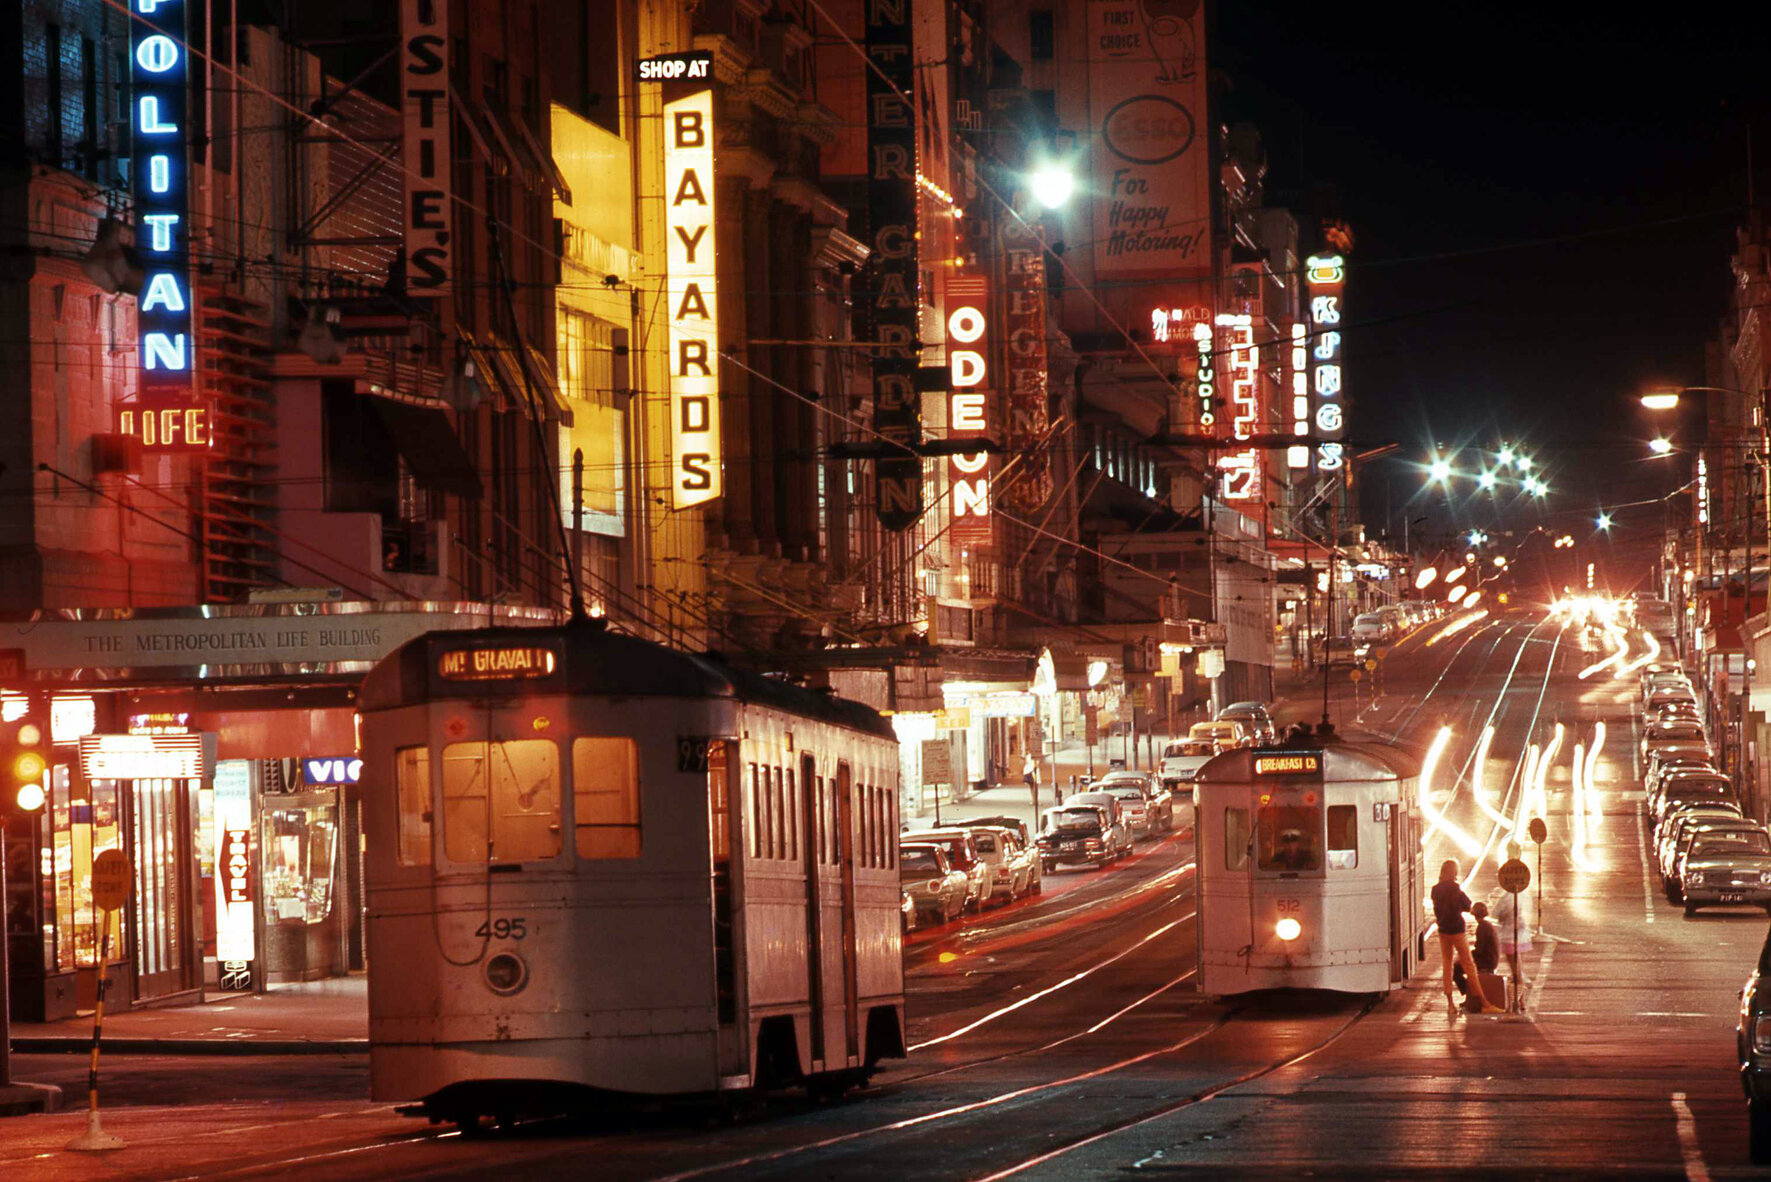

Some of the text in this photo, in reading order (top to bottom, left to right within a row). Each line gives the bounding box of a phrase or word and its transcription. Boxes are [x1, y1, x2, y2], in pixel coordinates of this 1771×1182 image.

[1103, 11, 1135, 26] FIRST
[1100, 33, 1142, 50] CHOICE
[639, 60, 710, 79] SHOP AT
[1111, 168, 1149, 196] For
[1109, 202, 1169, 229] Happy
[1106, 227, 1206, 260] Motoring!
[672, 111, 711, 491] BAYARDS
[1311, 296, 1344, 470] KINGS
[85, 629, 381, 652] THE METROPOLITAN LIFE BUILDING
[1262, 757, 1303, 771] BREAKFAST
[1374, 803, 1390, 822] 30
[1277, 901, 1300, 912] 512
[475, 917, 528, 940] 495
